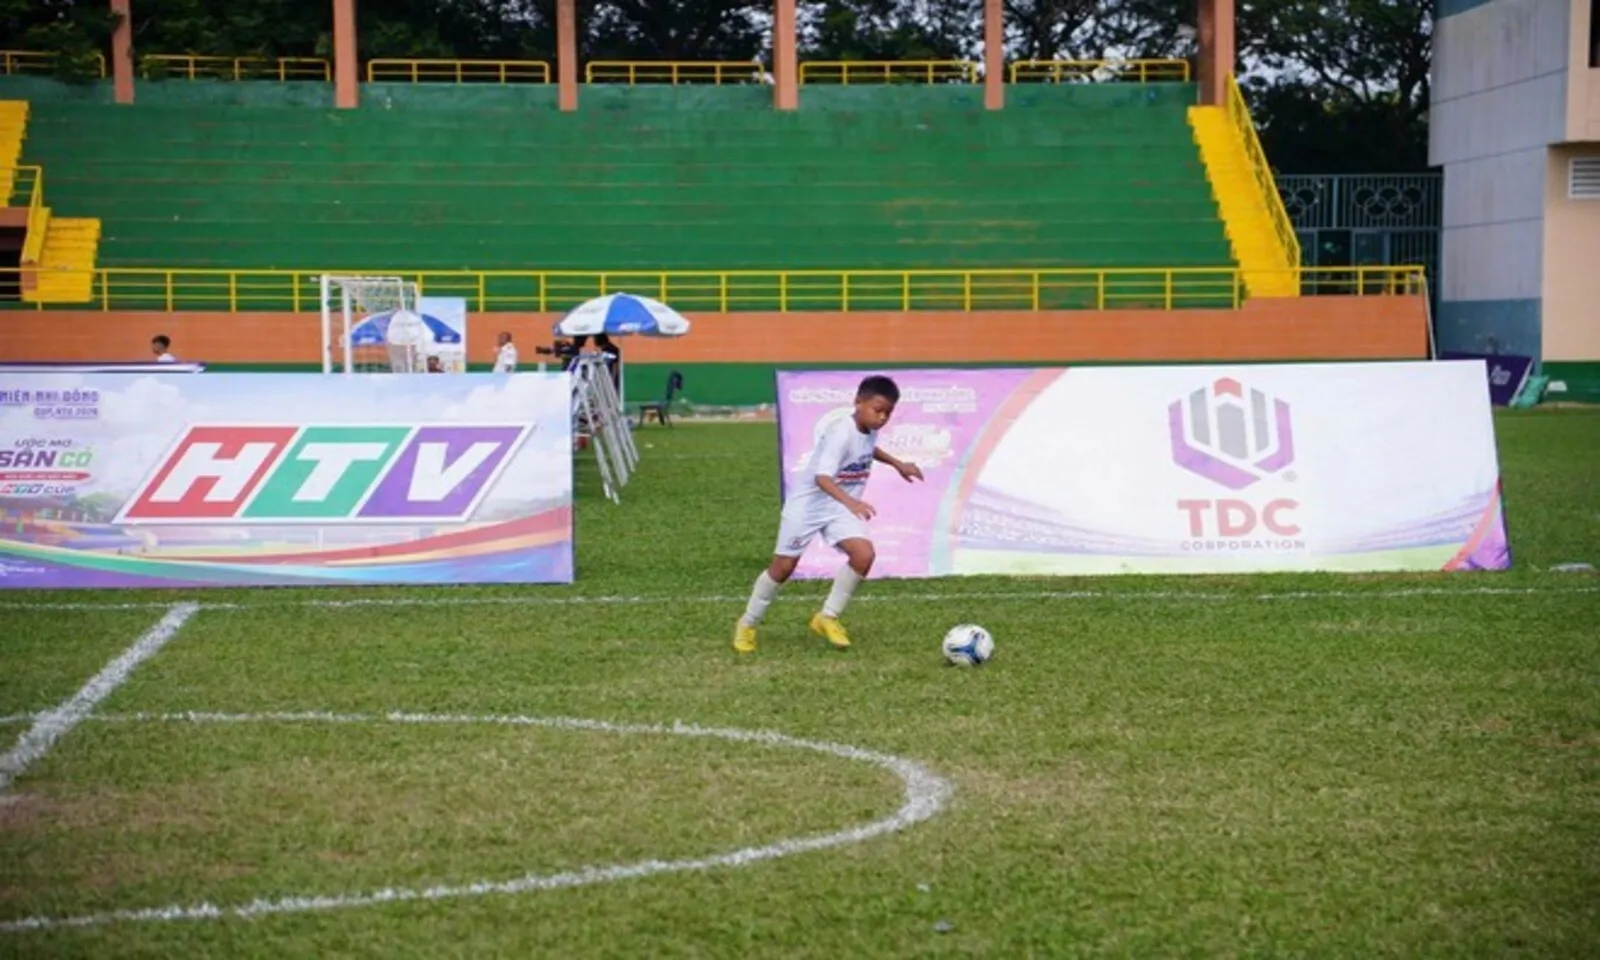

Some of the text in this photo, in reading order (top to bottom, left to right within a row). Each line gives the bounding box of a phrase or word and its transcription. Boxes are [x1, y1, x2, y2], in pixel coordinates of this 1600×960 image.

[147, 441, 502, 502] HTV
[1177, 498, 1301, 538] TDC
[1180, 540, 1305, 551] CORPORATION
